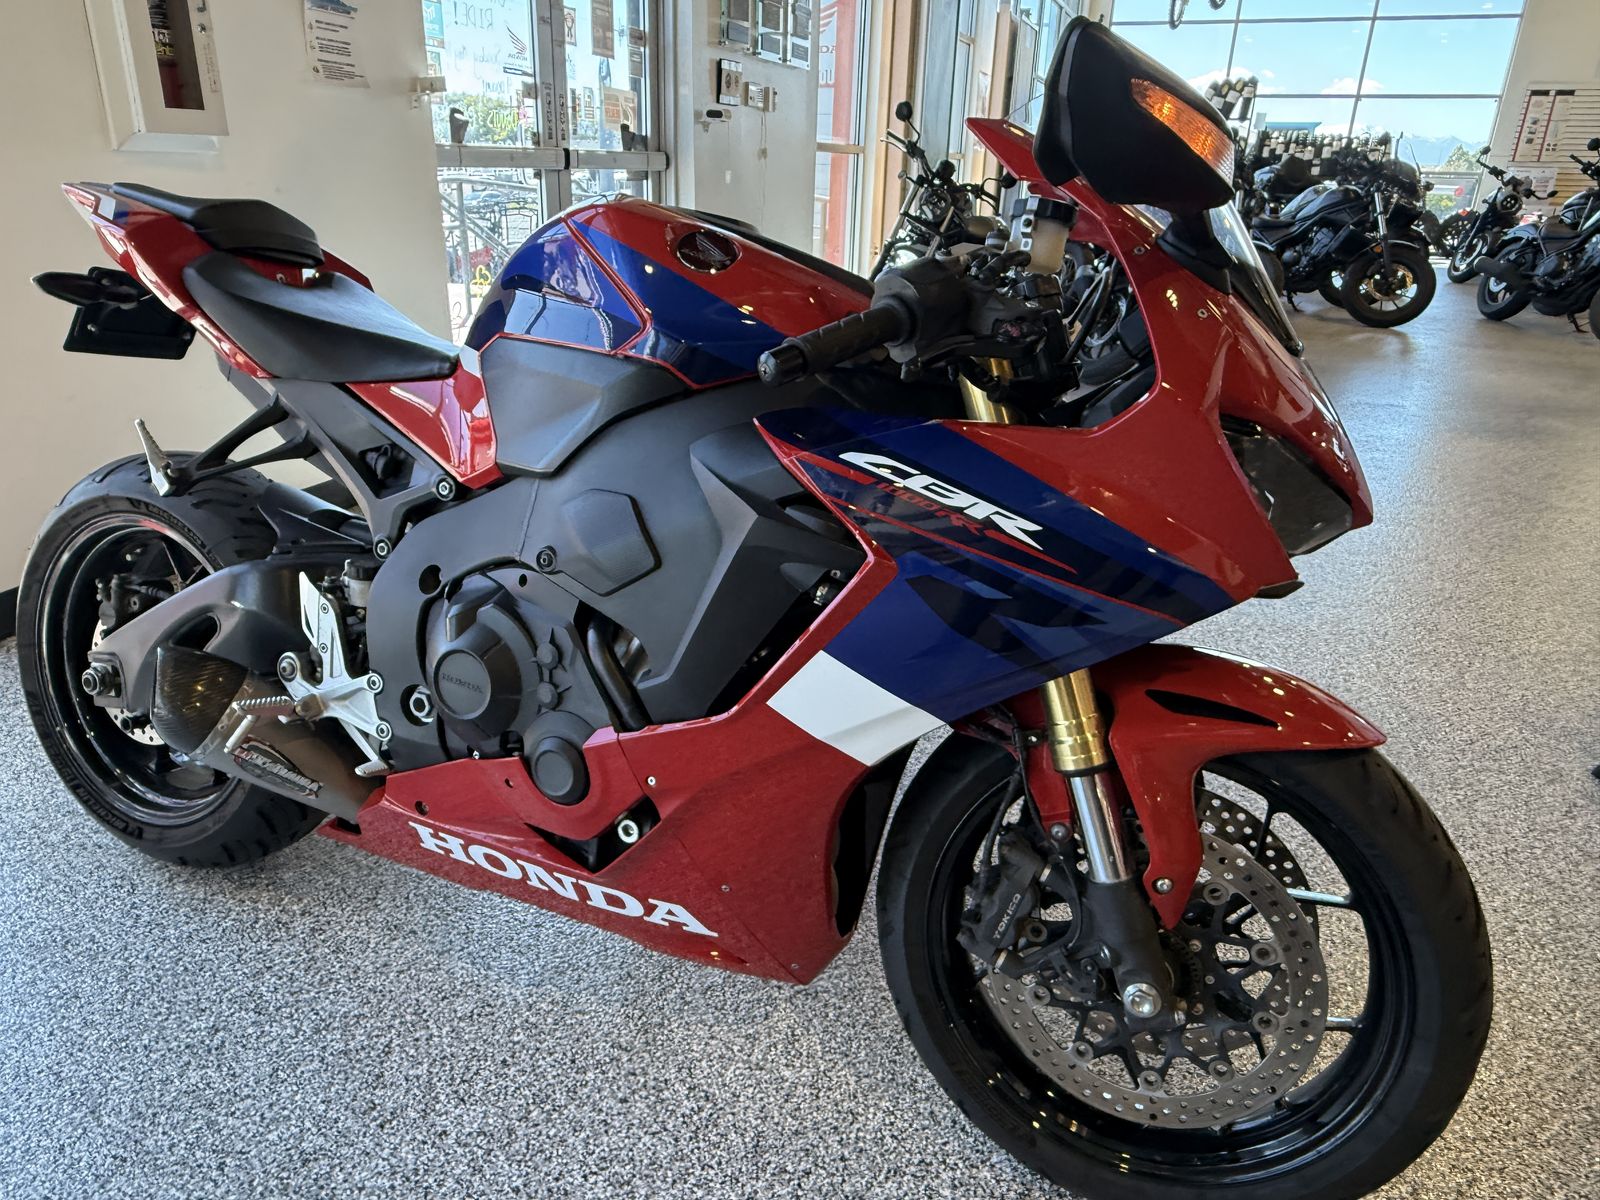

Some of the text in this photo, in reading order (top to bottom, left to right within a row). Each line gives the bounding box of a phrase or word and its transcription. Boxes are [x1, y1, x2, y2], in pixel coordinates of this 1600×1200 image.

[838, 451, 1044, 551] CBR
[441, 672, 484, 695] HONDA
[408, 821, 719, 938] HONDA
[992, 892, 1022, 940] TOKICO
